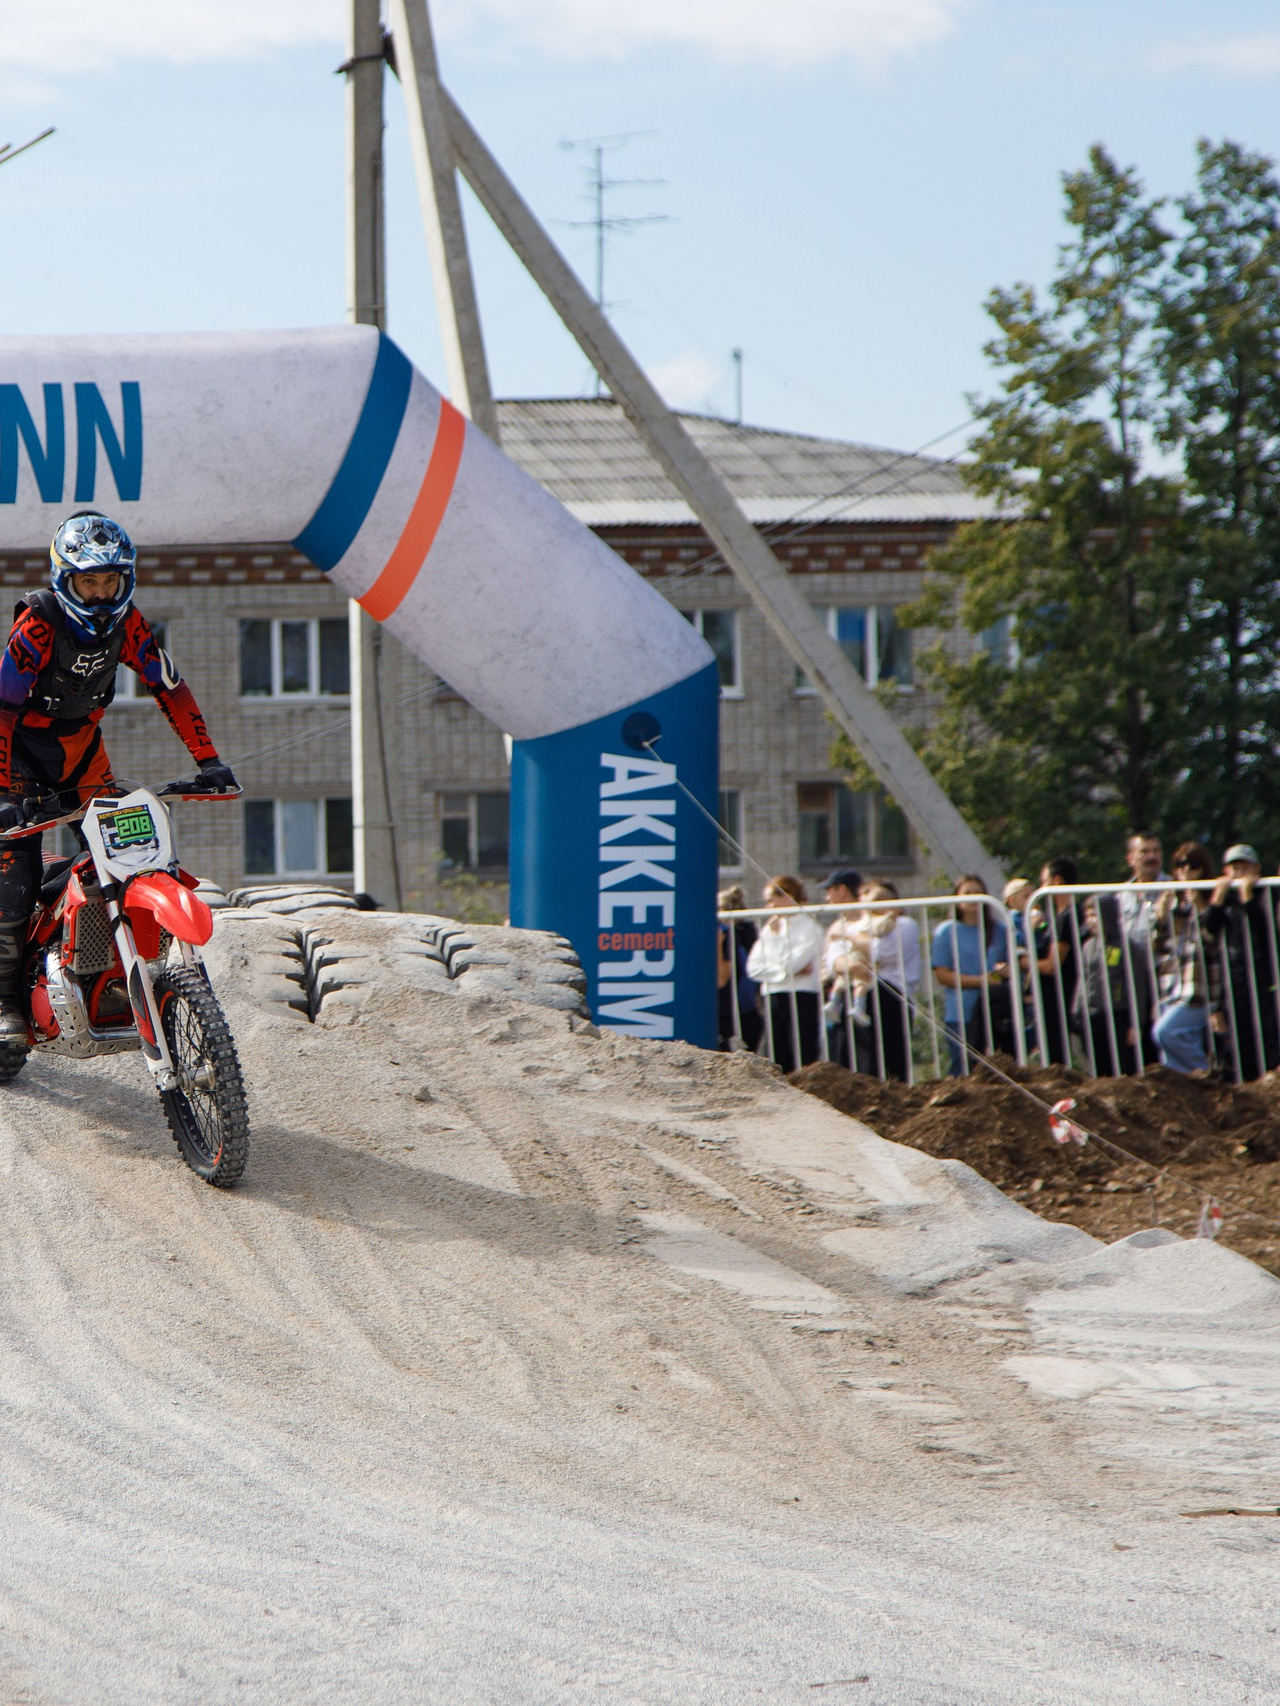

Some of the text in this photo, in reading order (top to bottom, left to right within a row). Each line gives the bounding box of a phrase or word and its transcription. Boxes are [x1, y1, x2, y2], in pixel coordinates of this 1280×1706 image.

[118, 816, 151, 837] 208
[597, 752, 677, 1038] AKKERM
[597, 929, 675, 951] cement
